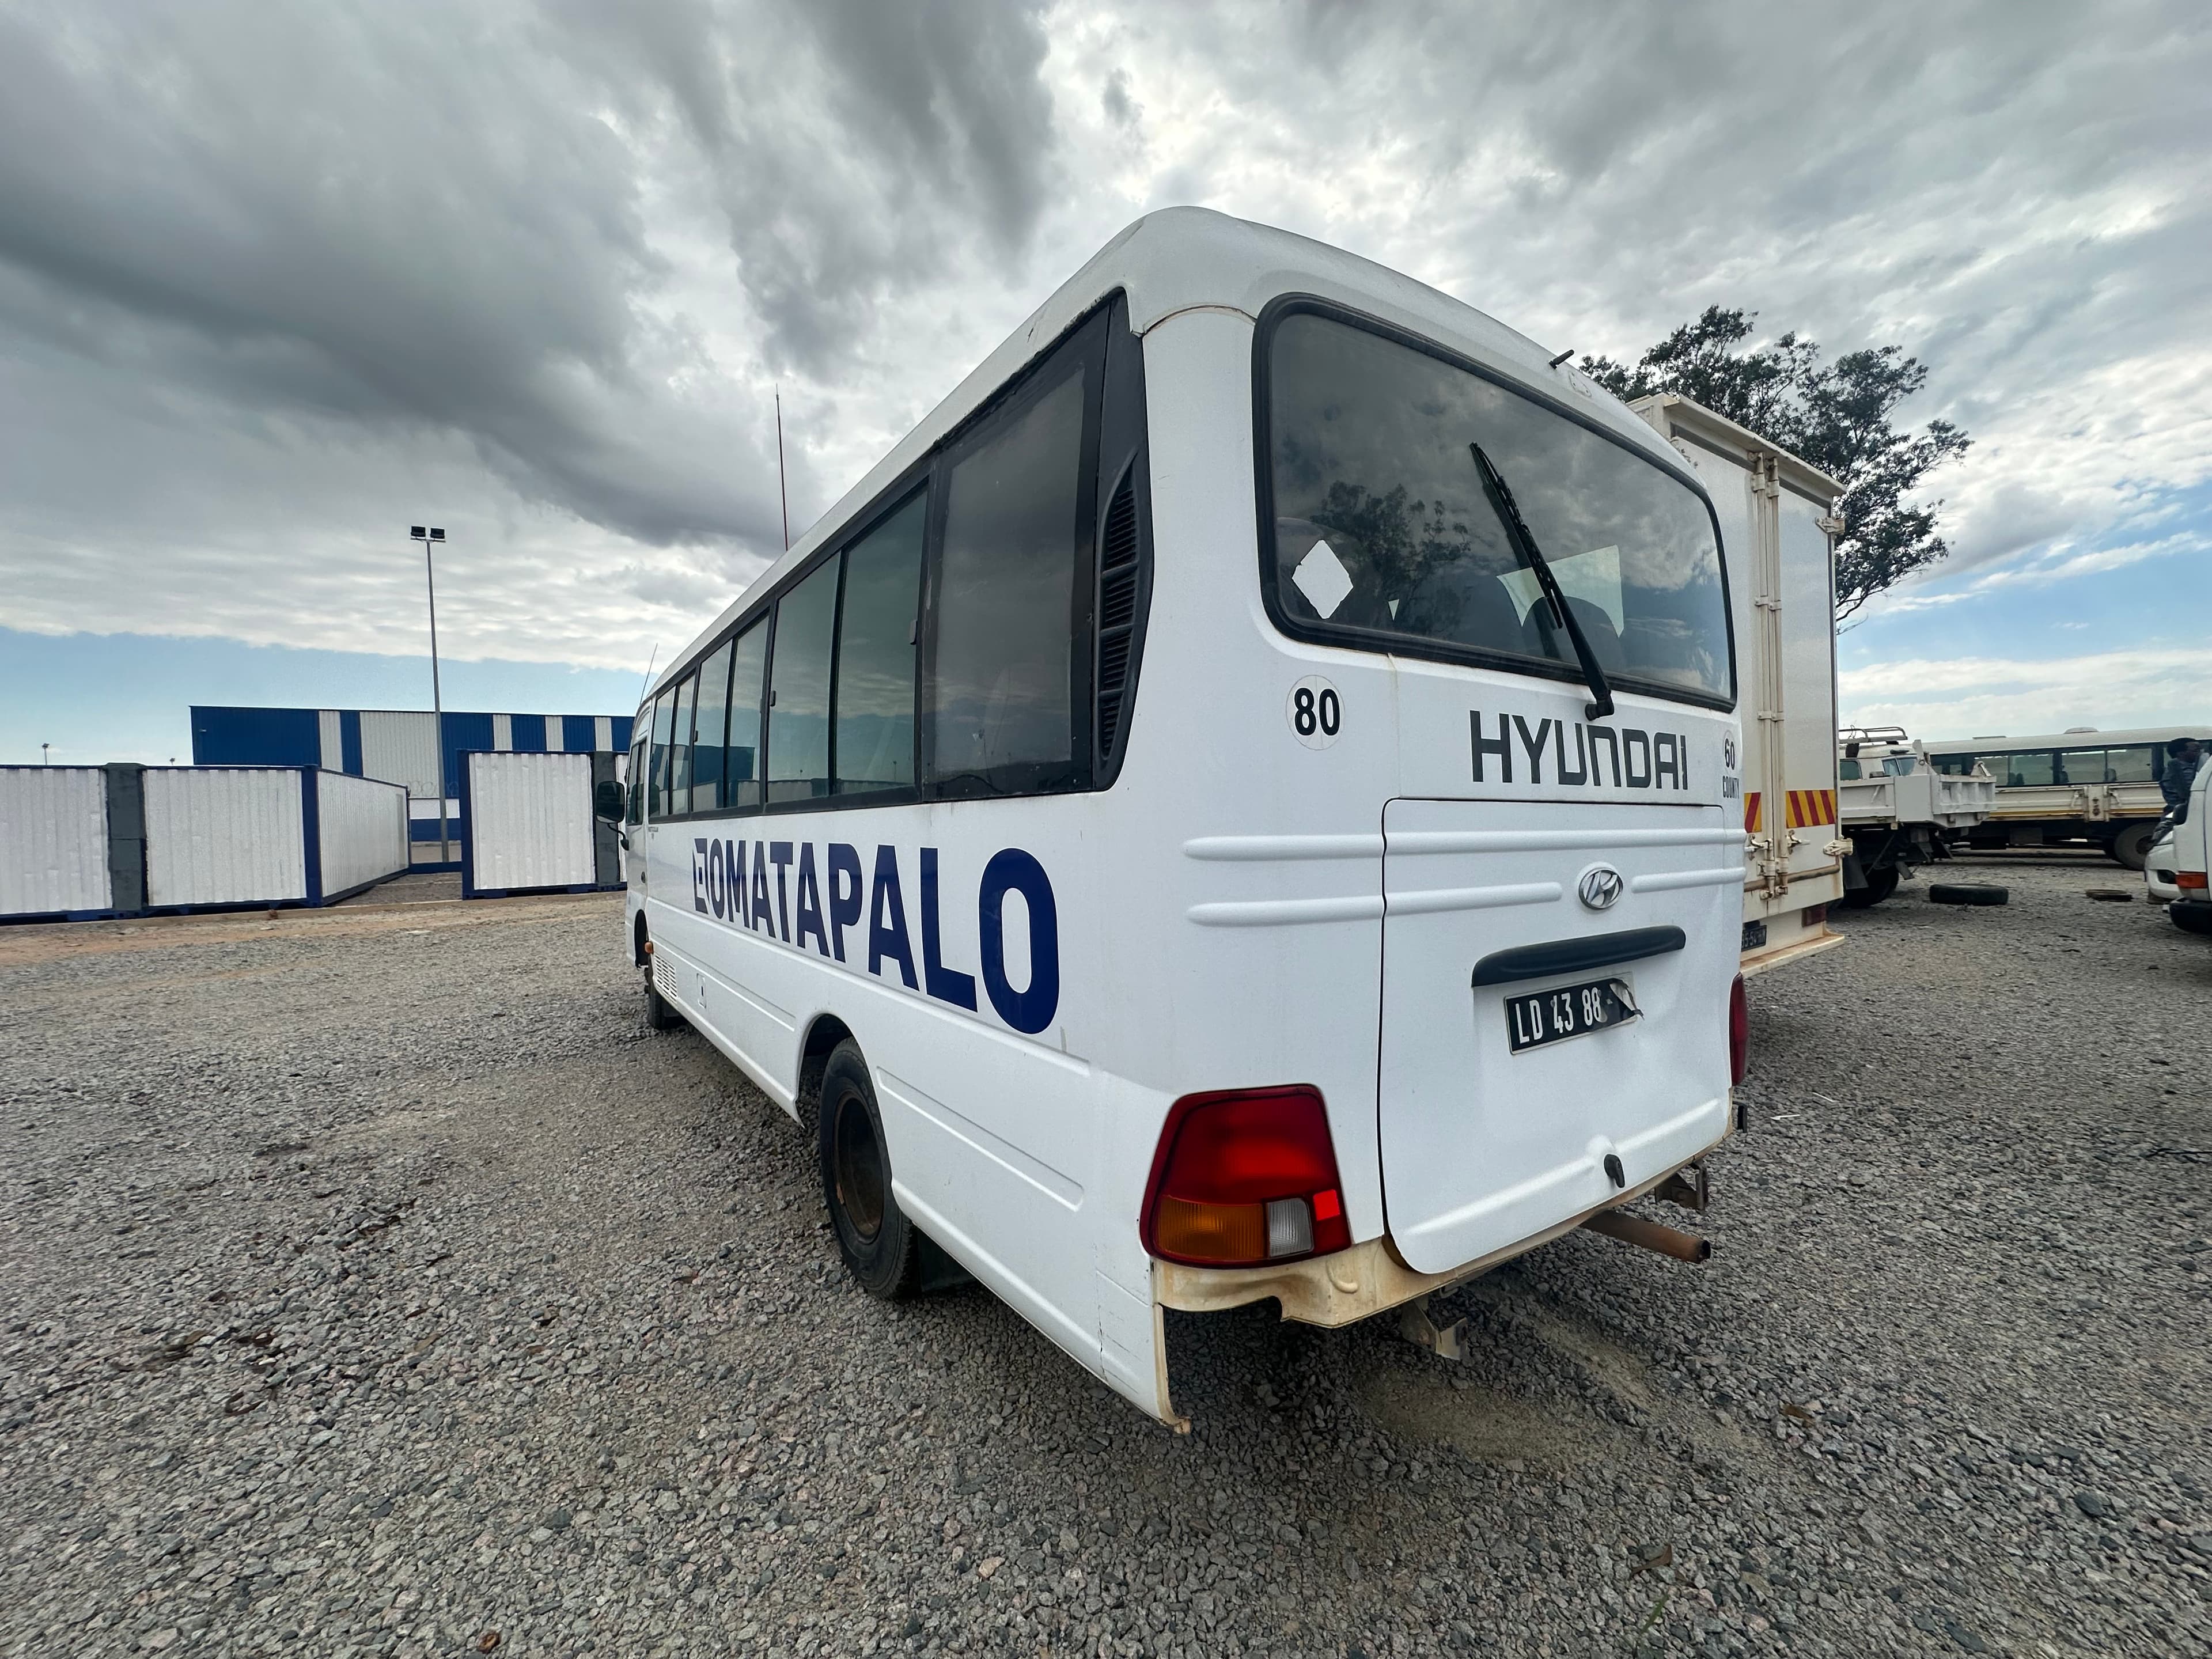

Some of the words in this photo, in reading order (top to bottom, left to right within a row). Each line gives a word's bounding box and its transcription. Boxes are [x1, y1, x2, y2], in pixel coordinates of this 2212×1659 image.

[1294, 688, 1340, 736] 80
[1469, 710, 1688, 790] HYUNDAI
[1725, 738, 1735, 770] 60
[1722, 775, 1740, 800] COUNTY
[710, 838, 1059, 1034] OMATAPALO
[1515, 999, 1543, 1044] LD
[1553, 993, 1574, 1033] 43
[1582, 987, 1603, 1026] 88
